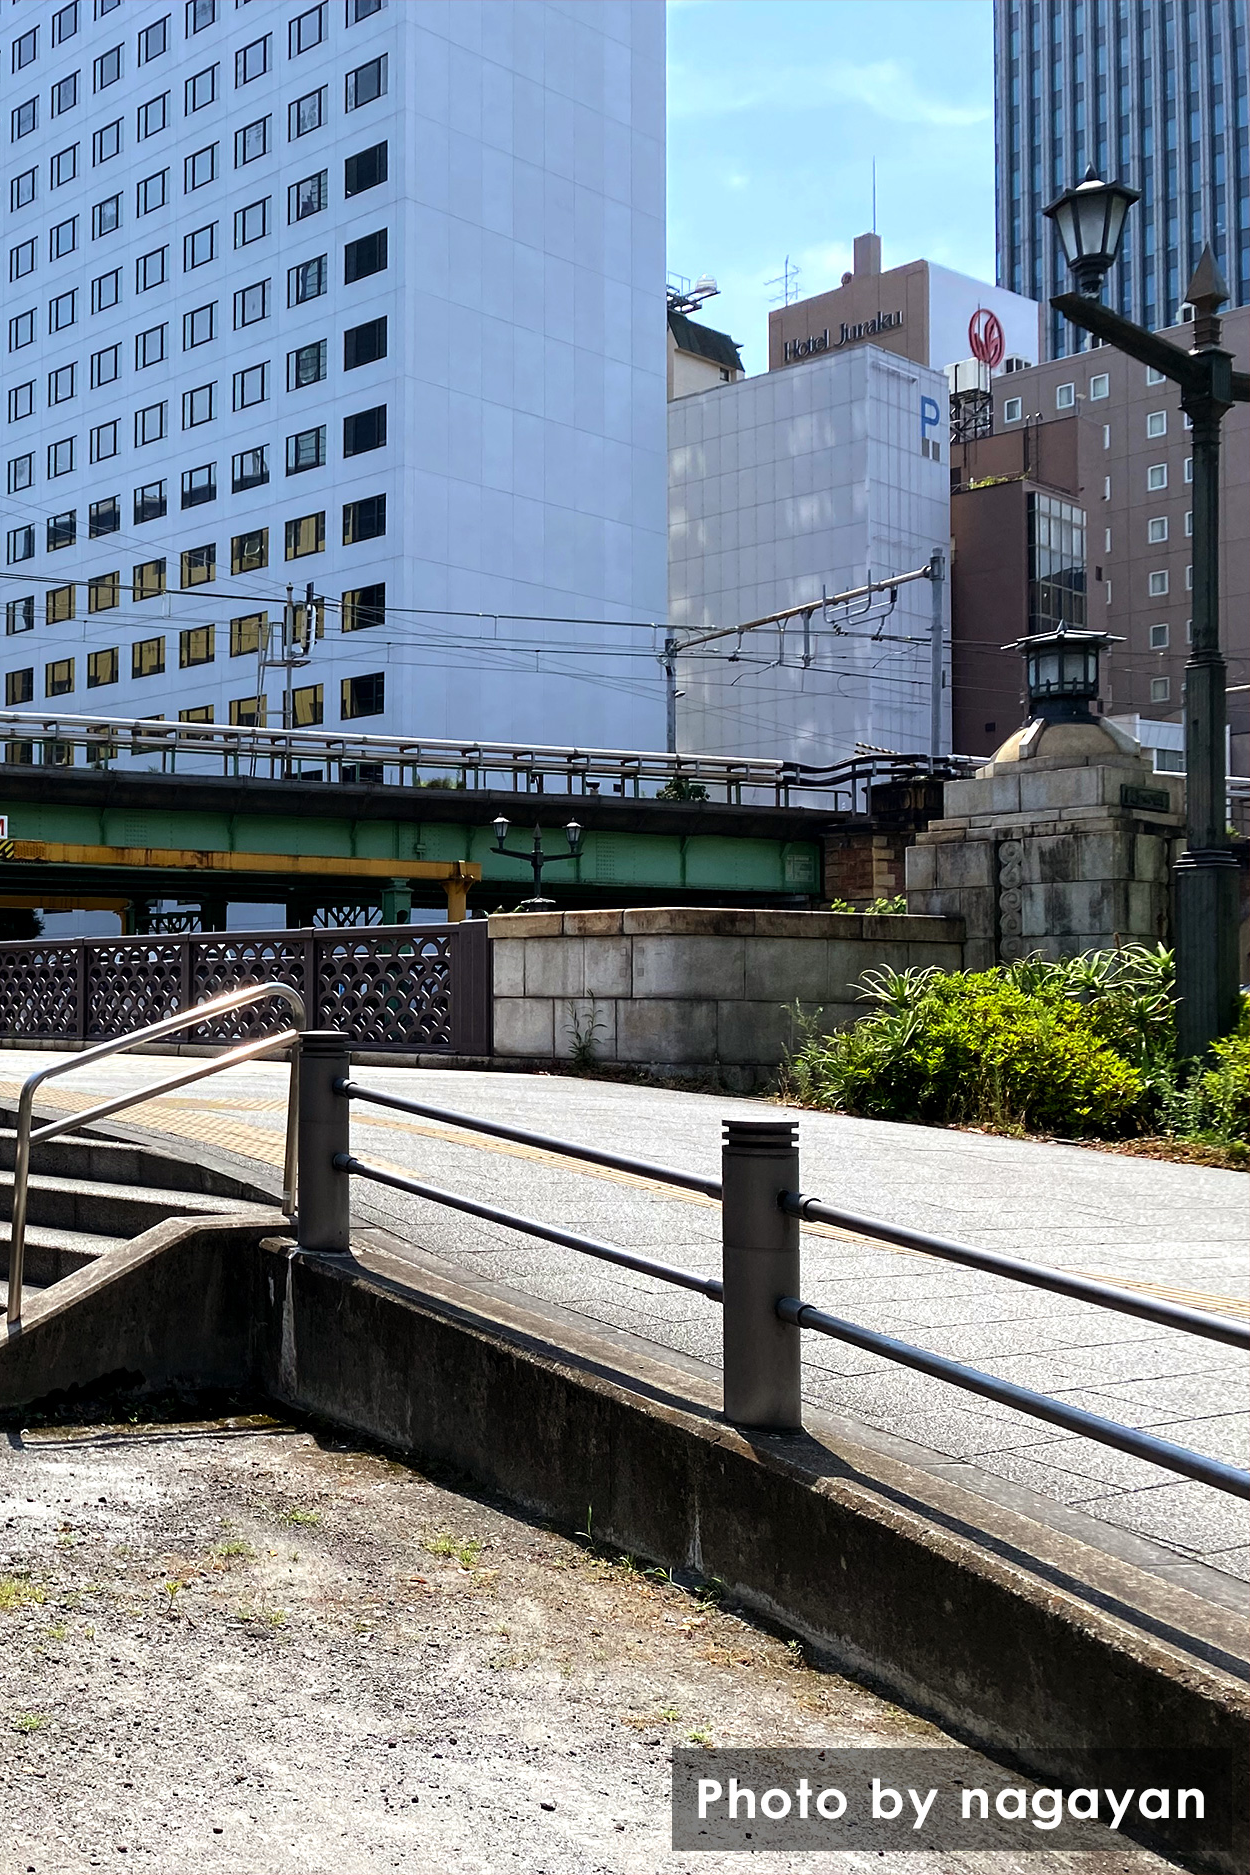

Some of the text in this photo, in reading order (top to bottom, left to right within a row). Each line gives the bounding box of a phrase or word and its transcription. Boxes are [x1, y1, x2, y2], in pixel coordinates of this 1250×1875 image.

[784, 310, 904, 361] Hotel Juraku
[921, 395, 940, 437] P
